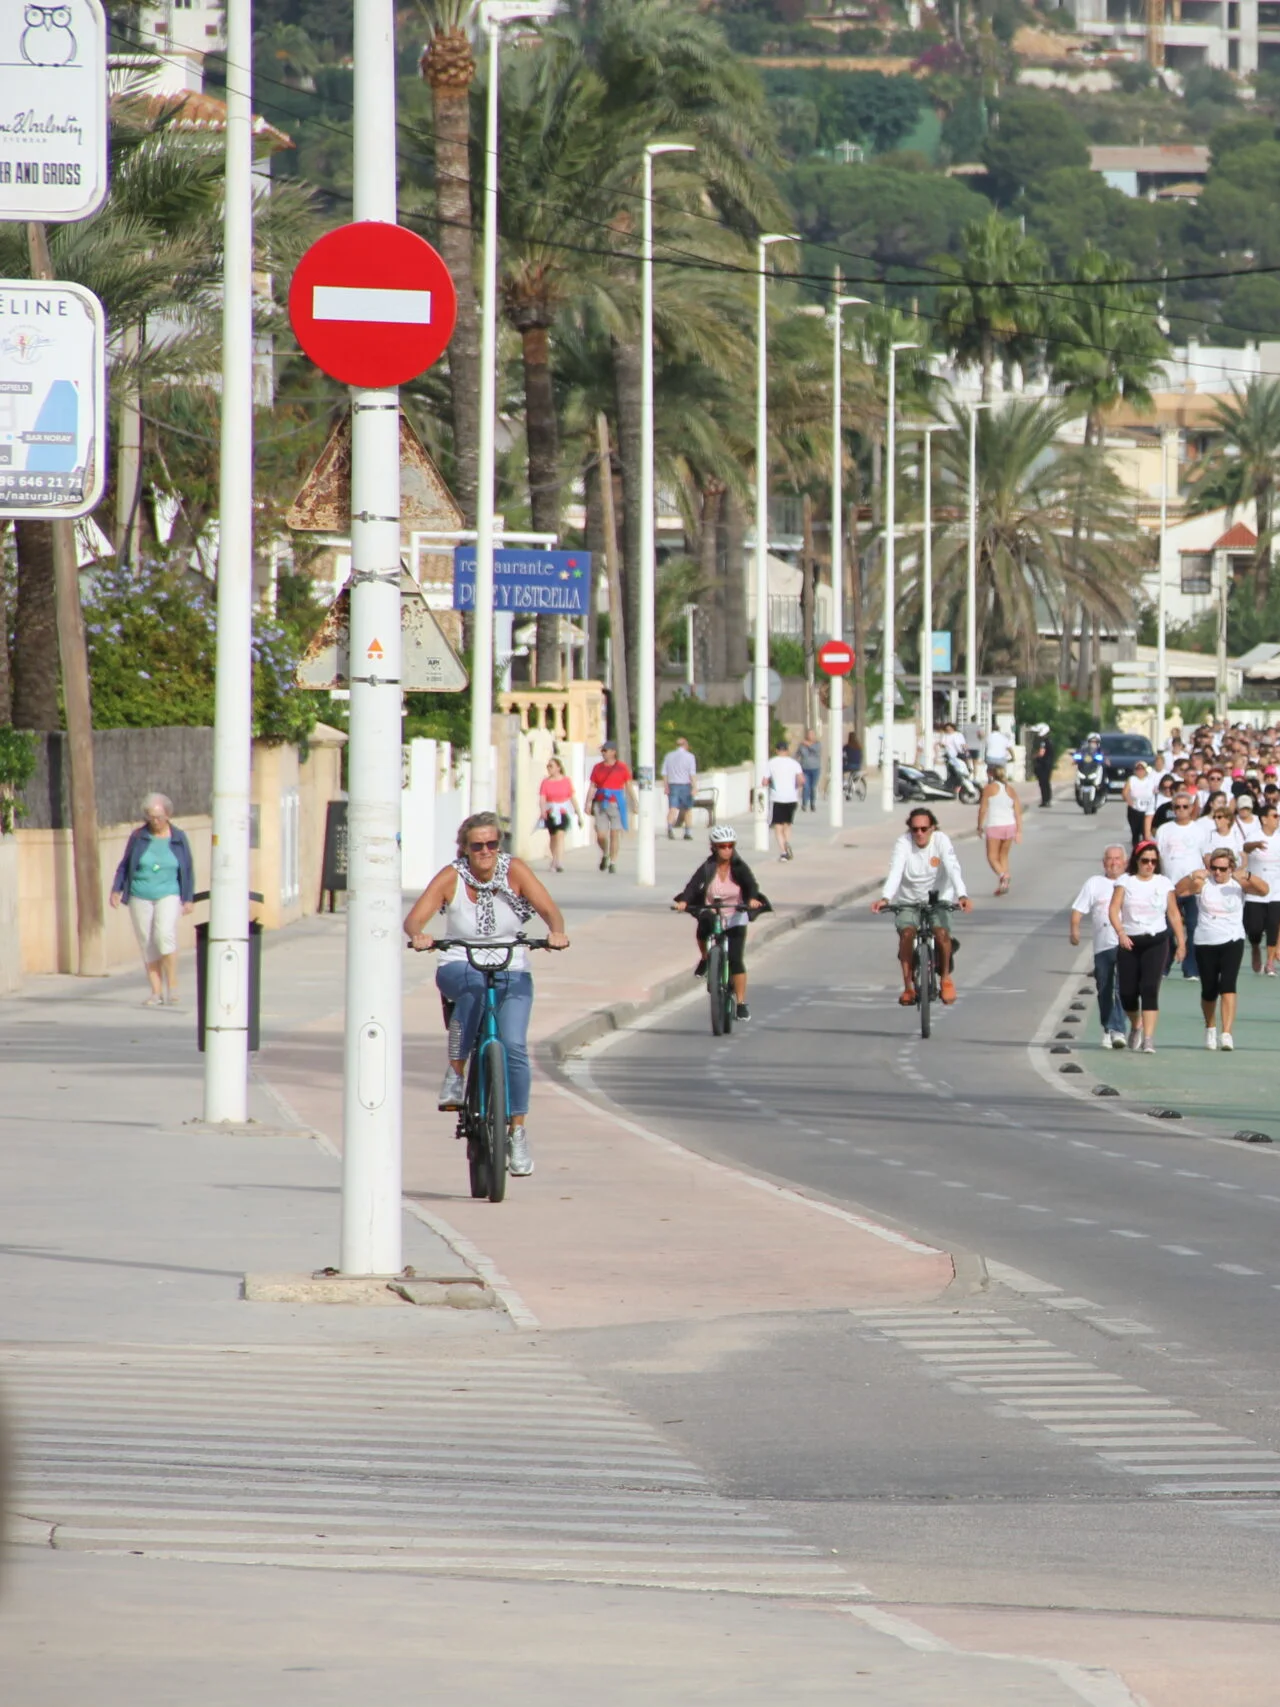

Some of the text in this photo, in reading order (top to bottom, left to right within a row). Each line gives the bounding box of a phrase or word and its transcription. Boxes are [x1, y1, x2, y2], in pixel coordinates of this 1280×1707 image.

[16, 162, 39, 184] AND
[43, 162, 81, 185] GROSS
[19, 476, 43, 487] 646
[47, 477, 63, 488] 21
[68, 478, 82, 489] 71
[460, 558, 555, 576] reaurante
[501, 584, 512, 607] Y
[514, 585, 582, 610] ESTRELLA
